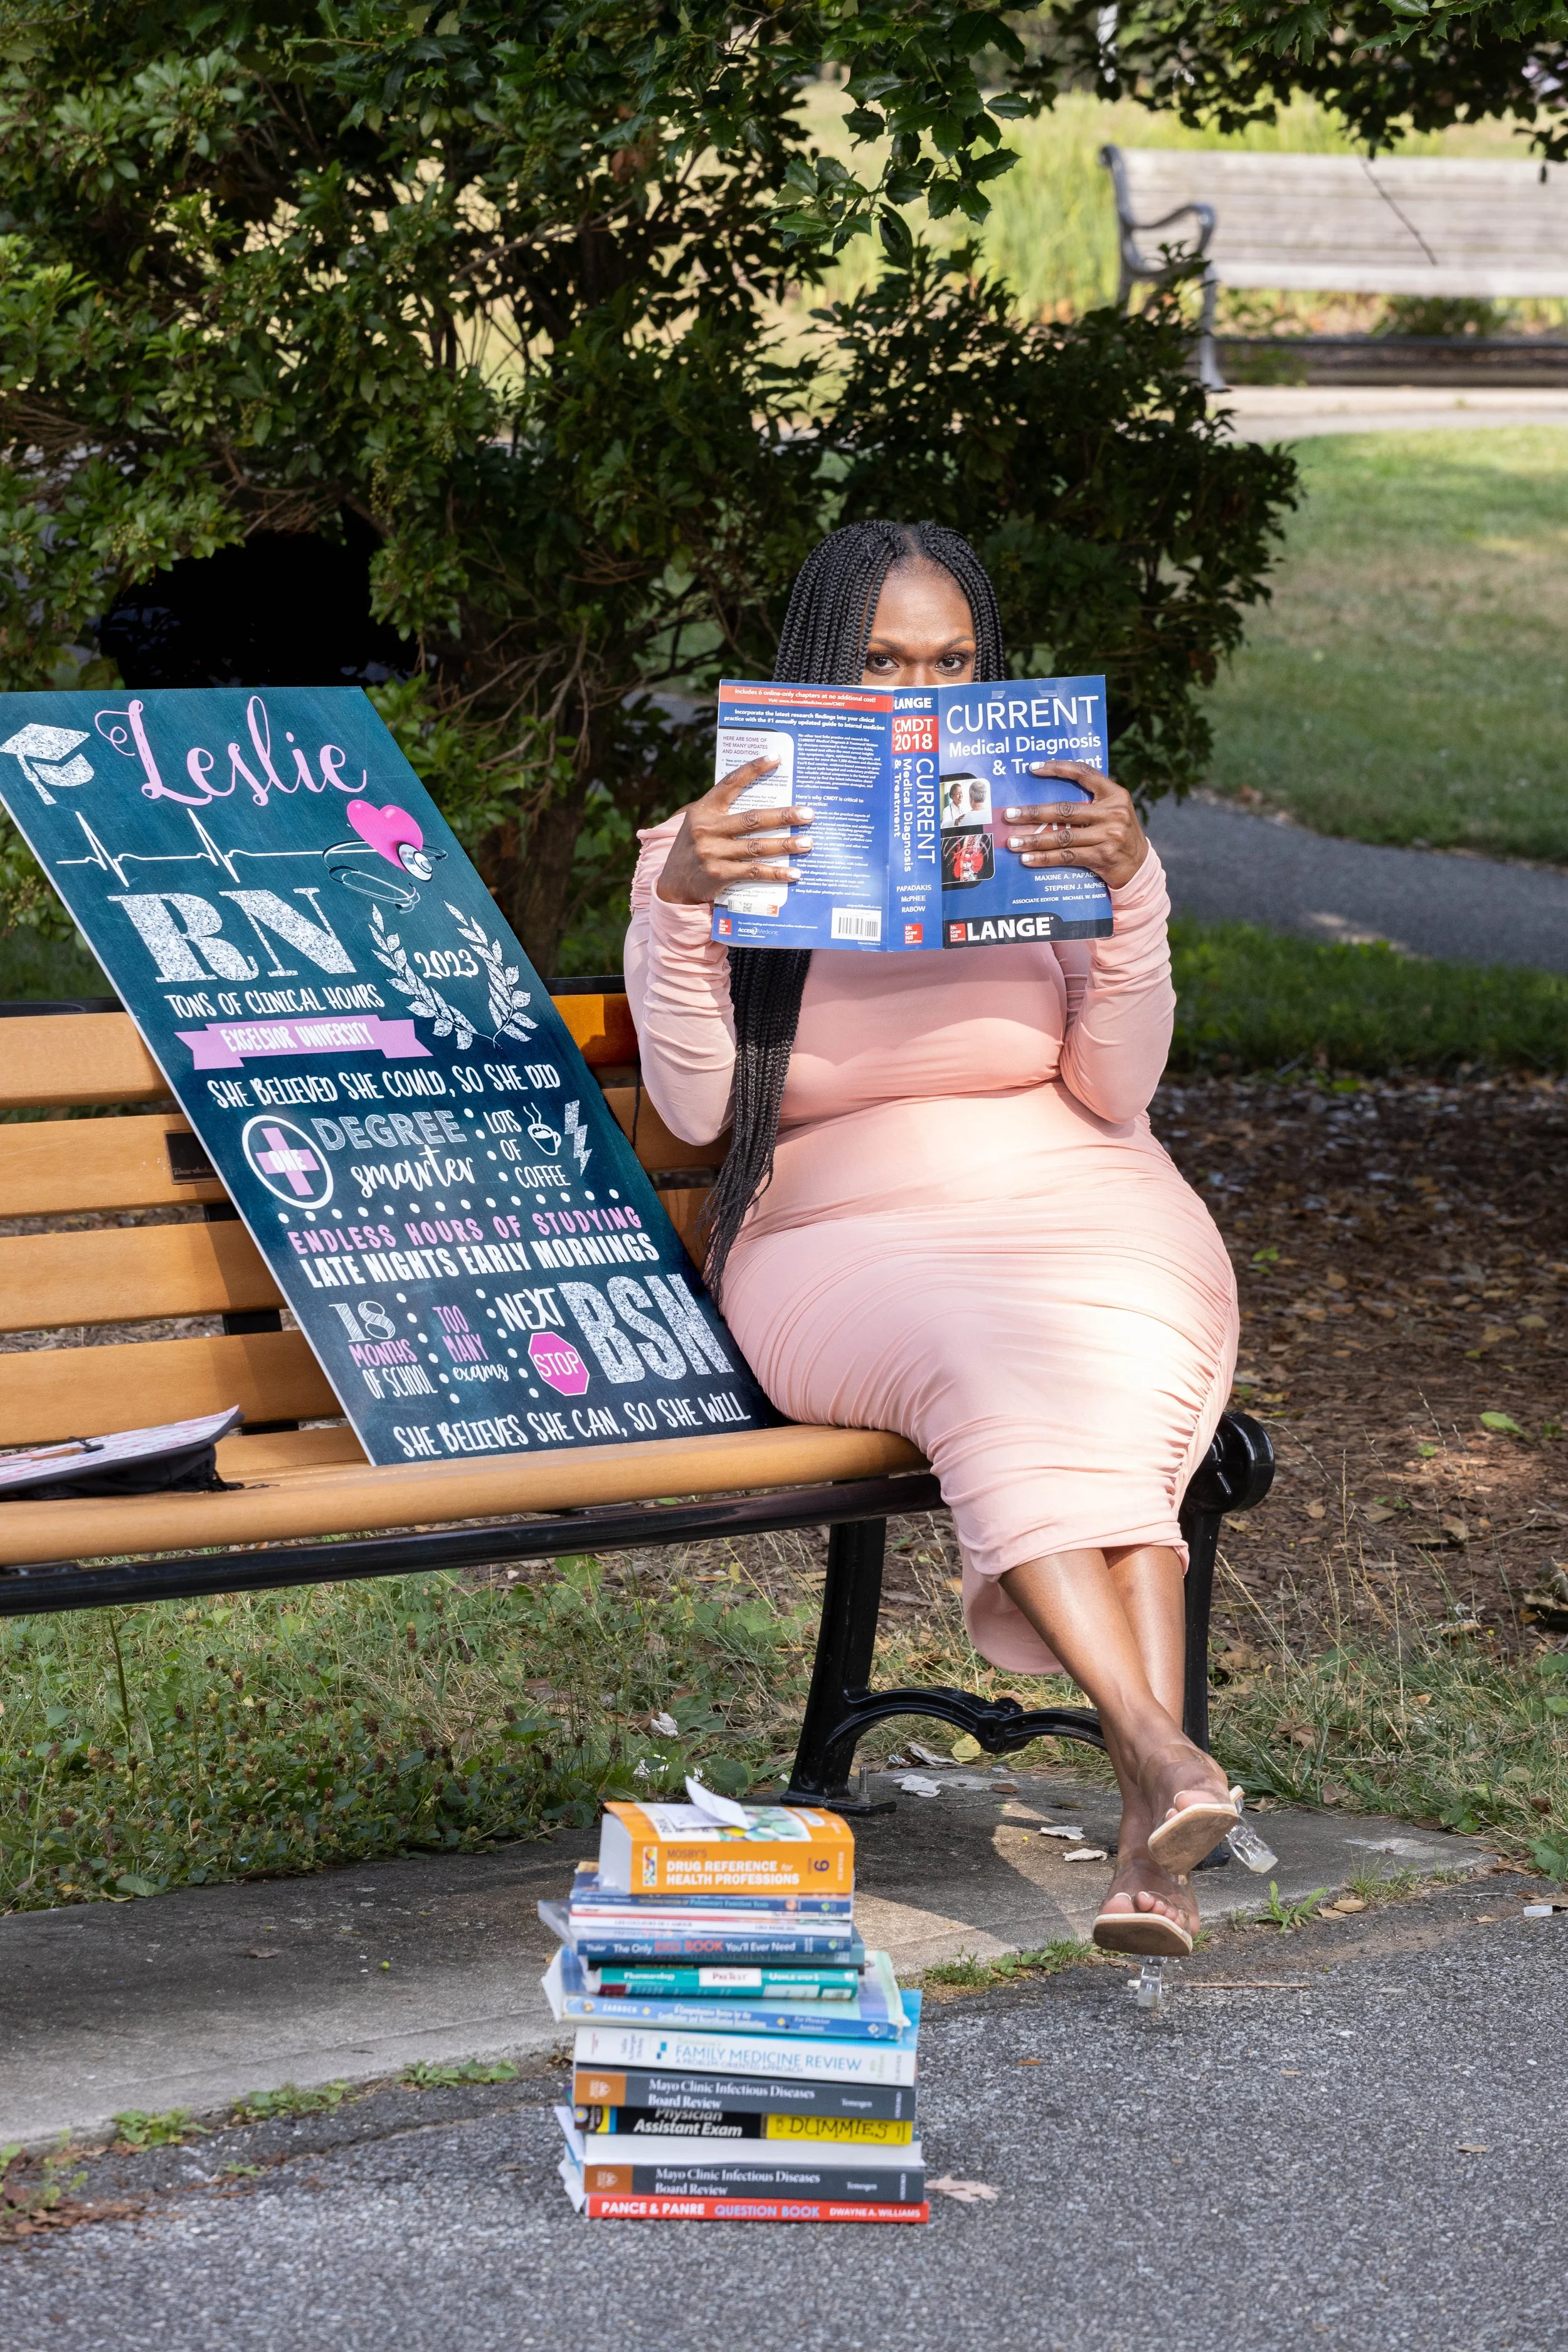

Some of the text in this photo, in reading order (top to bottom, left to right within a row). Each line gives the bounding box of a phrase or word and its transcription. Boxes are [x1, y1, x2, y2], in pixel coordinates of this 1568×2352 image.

[763, 690, 795, 698] online-only
[894, 697, 933, 710] LANGE
[894, 719, 933, 733] CMDT
[946, 696, 1099, 734] CURRENT
[95, 696, 367, 806] Leslie
[894, 733, 933, 751] 2018
[949, 732, 1101, 758] Medical Diagnosis
[894, 759, 901, 769] &
[992, 760, 1007, 776] &
[902, 758, 913, 872] Medical Diagnosis
[916, 758, 935, 864] CURRENT
[107, 887, 358, 983] RN
[967, 916, 1054, 941] LANGE
[413, 948, 479, 980] 2023
[164, 983, 386, 1019] TONS OF CLINICAL HOURS
[220, 1020, 374, 1052] EXCELSIOR UNIVERSITY
[207, 1063, 561, 1109] SHE BELIEVED SHE COULD, SO SHE DID
[311, 1110, 468, 1151] DEGREE
[482, 1109, 522, 1135] LOTS
[267, 1148, 309, 1172] ONE
[500, 1139, 522, 1162] OF
[349, 1143, 476, 1199] smarter
[514, 1165, 571, 1189] COFFEE
[287, 1205, 642, 1255] ENDLESS HOURS OF STUDYING
[299, 1232, 659, 1288] LATE NIGHTS EARLY MORNINGS
[329, 1300, 396, 1343] 18
[432, 1305, 470, 1333] TOO
[494, 1288, 565, 1332] NEXT
[556, 1273, 734, 1384] BSN
[348, 1338, 418, 1368] MONTHS
[442, 1333, 489, 1363] MANY
[452, 1364, 509, 1382] exams
[532, 1350, 580, 1378] STOP
[362, 1364, 438, 1399] OF SCHOOL
[393, 1391, 752, 1458] SHE BELIEVES SHE CAN, SO SHE WILL
[666, 1860, 702, 1872] DRUG
[704, 1860, 777, 1872] REFERENCE
[781, 1862, 793, 1872] for
[667, 1849, 707, 1858] MOSBY'S
[813, 1859, 830, 1872] 9
[666, 1873, 800, 1885] HEALTH PROFESSIONS
[613, 1939, 797, 1955] The Only EKG BOOK You'll Ever Need
[623, 1971, 675, 1981] Pharmacology
[675, 2044, 726, 2060] FAMILY
[729, 2047, 802, 2066] MEDICINE
[805, 2055, 862, 2070] REVIEW
[649, 2078, 815, 2099] Mayo Clinic Infectious Diseases
[647, 2094, 722, 2109] Board Review
[655, 2107, 723, 2122] Physician
[633, 2119, 743, 2137] Assistant Exam
[790, 2117, 890, 2139] DUMMIES
[656, 2168, 820, 2184] Mayo Clinic Infectious Diseases
[655, 2182, 728, 2196] Board Review
[601, 2202, 921, 2218] PANCE & PANRE QUESTION BOOK DWAYNE A. WILLIAMS
